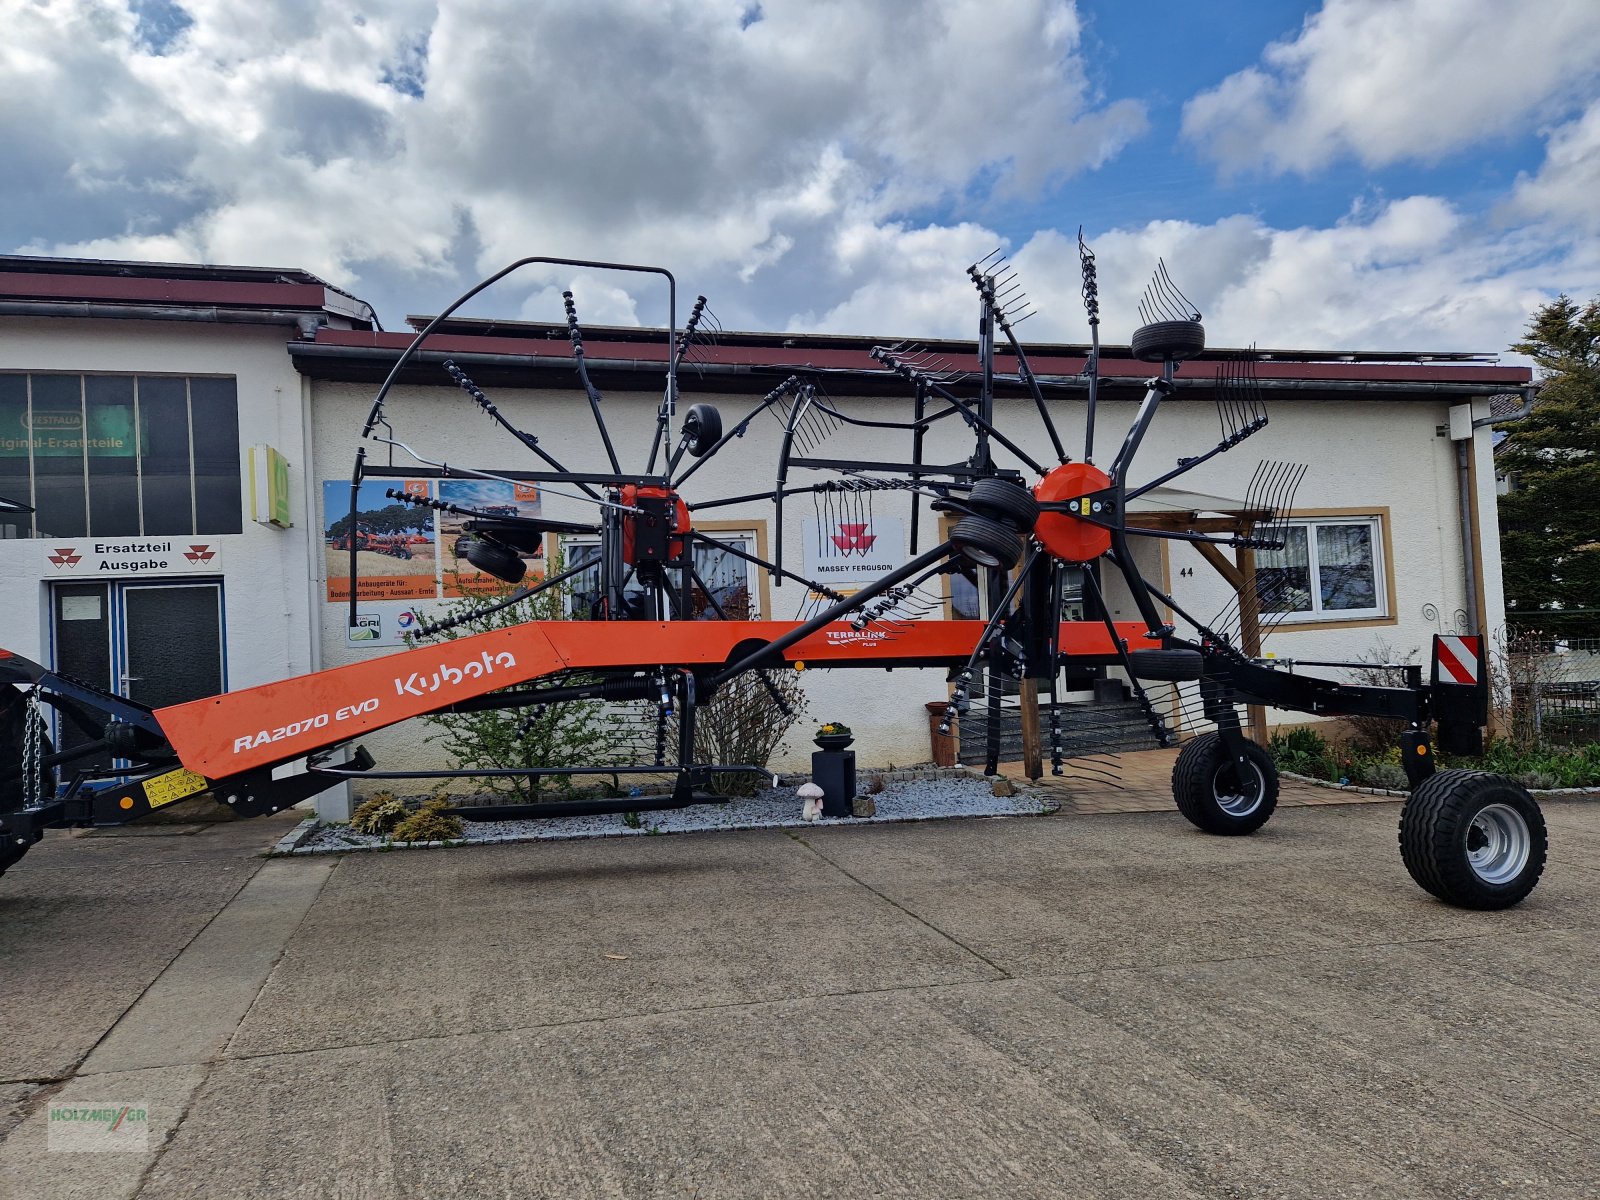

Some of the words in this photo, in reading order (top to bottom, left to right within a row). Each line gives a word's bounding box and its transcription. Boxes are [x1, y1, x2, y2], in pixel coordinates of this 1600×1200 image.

[95, 542, 171, 554] Ersatzteil
[99, 559, 168, 571] Ausgabe
[852, 564, 893, 572] FERGUSON
[1180, 567, 1193, 577] 44
[357, 580, 395, 588] Anbaugeräte
[826, 631, 886, 639] TERRALINK
[395, 651, 516, 696] Kubota
[233, 713, 329, 754] RA2070
[335, 698, 379, 721] EVO
